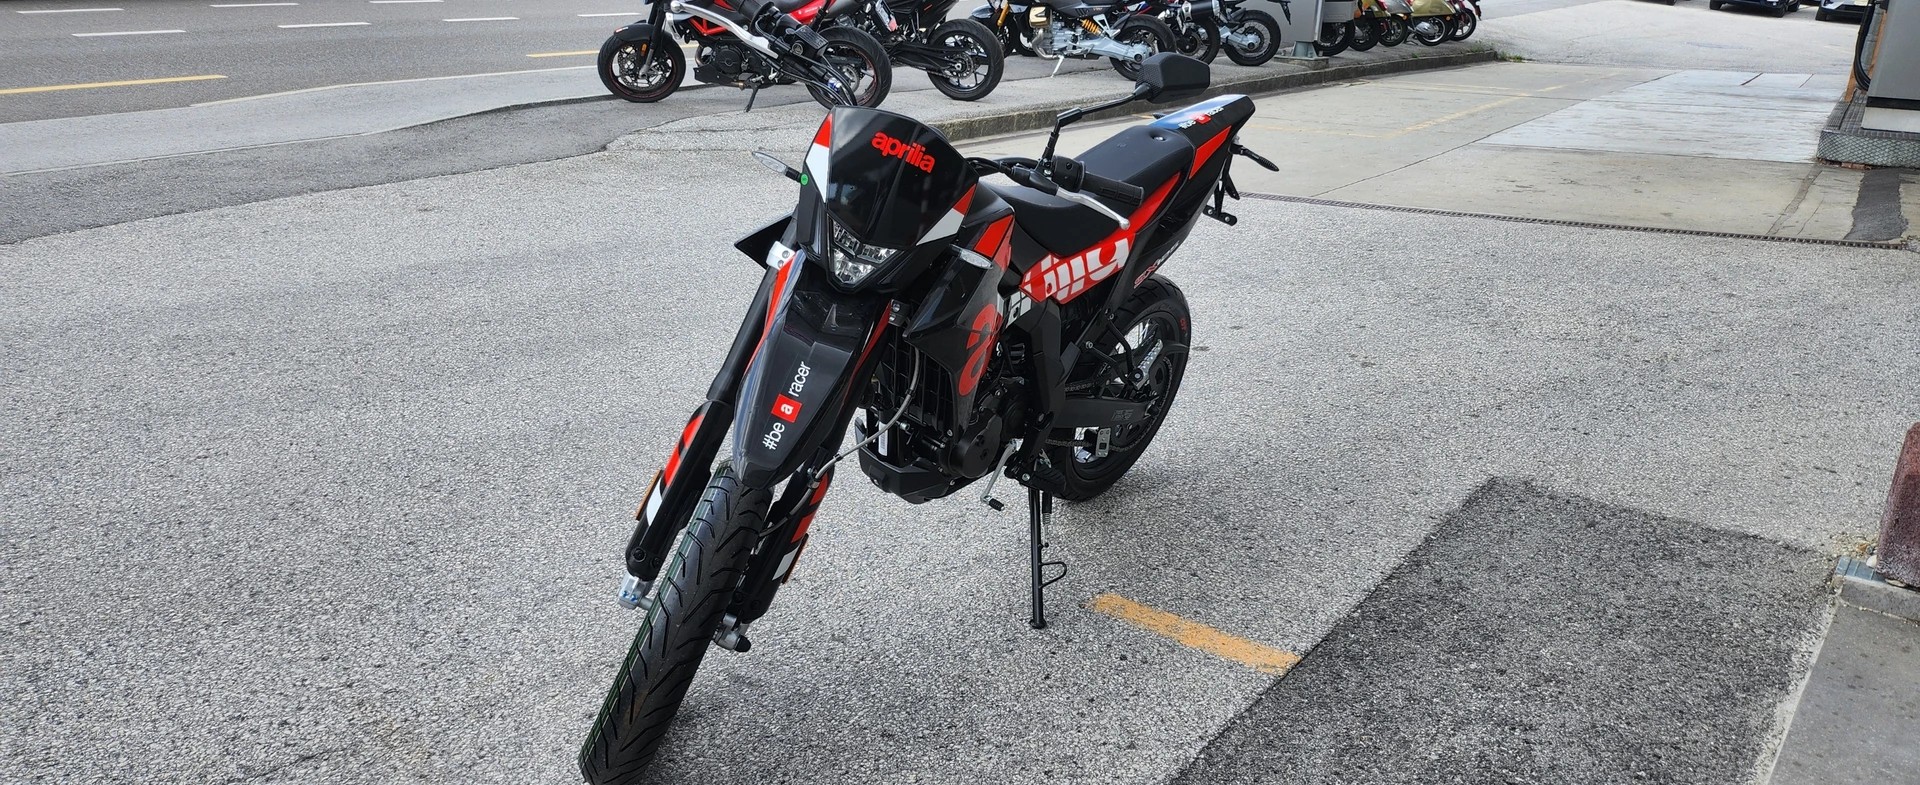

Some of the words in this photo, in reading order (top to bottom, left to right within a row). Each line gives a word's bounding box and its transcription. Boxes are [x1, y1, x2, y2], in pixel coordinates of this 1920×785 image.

[871, 131, 936, 174] aprilia
[762, 422, 786, 451] #be
[780, 403, 795, 416] a
[788, 360, 812, 398] racer
